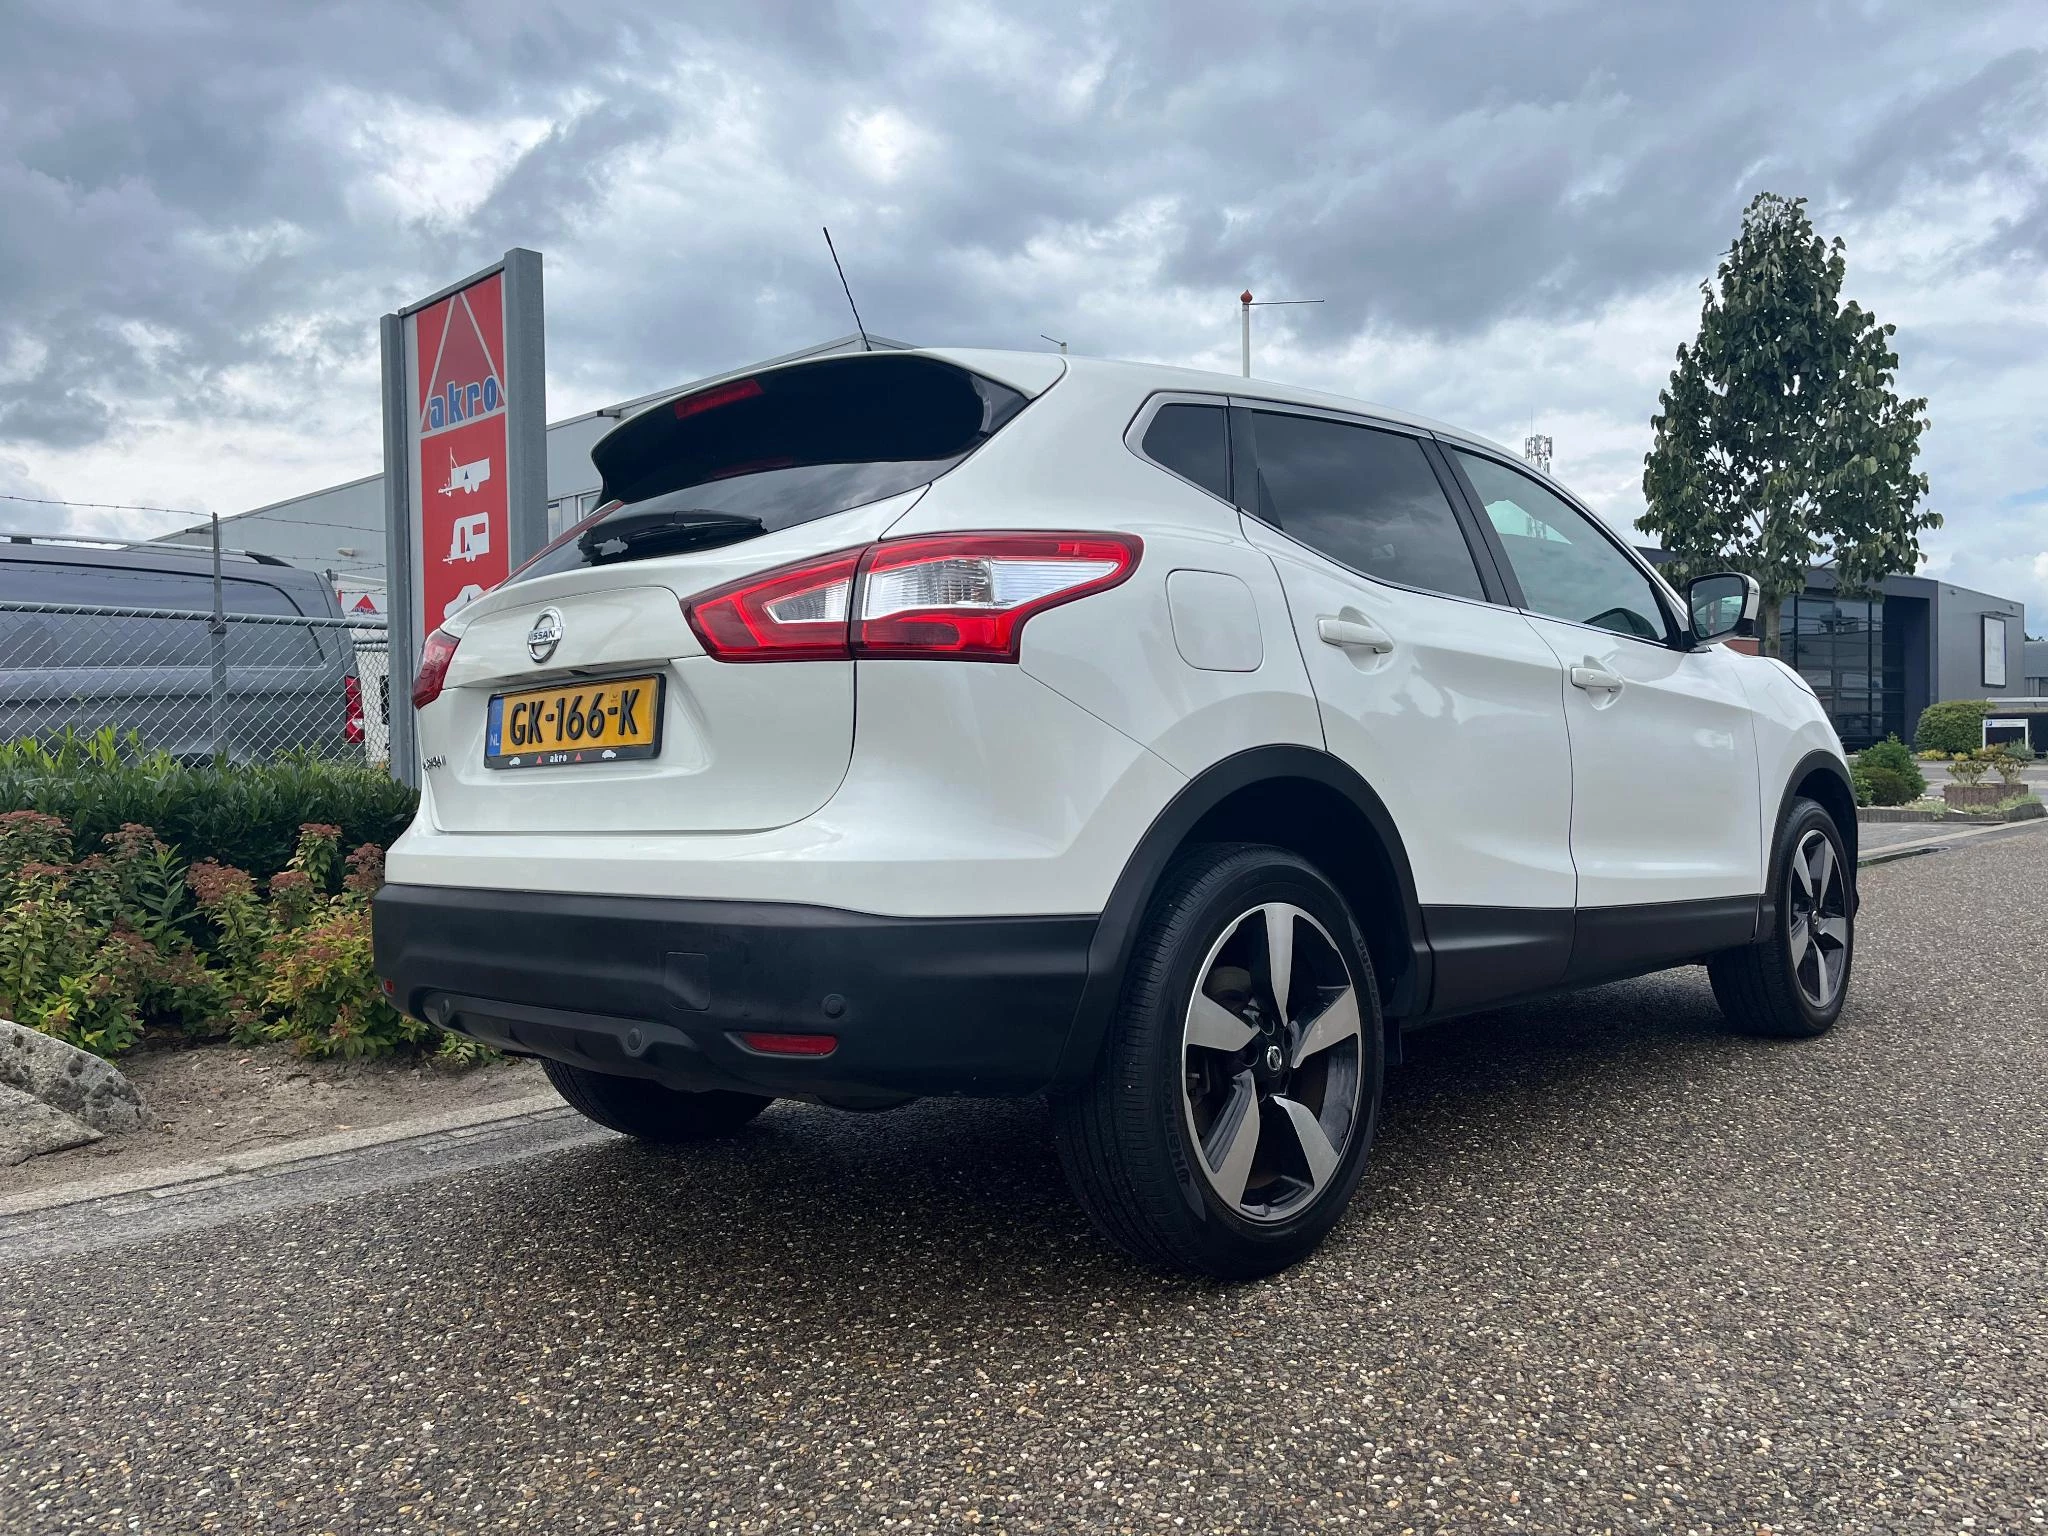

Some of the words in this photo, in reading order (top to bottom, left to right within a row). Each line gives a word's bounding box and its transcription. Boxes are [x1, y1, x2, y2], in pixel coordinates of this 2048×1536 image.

[429, 375, 499, 430] akro
[510, 688, 640, 746] GK-166-K
[489, 734, 500, 746] NL
[550, 753, 568, 763] akro
